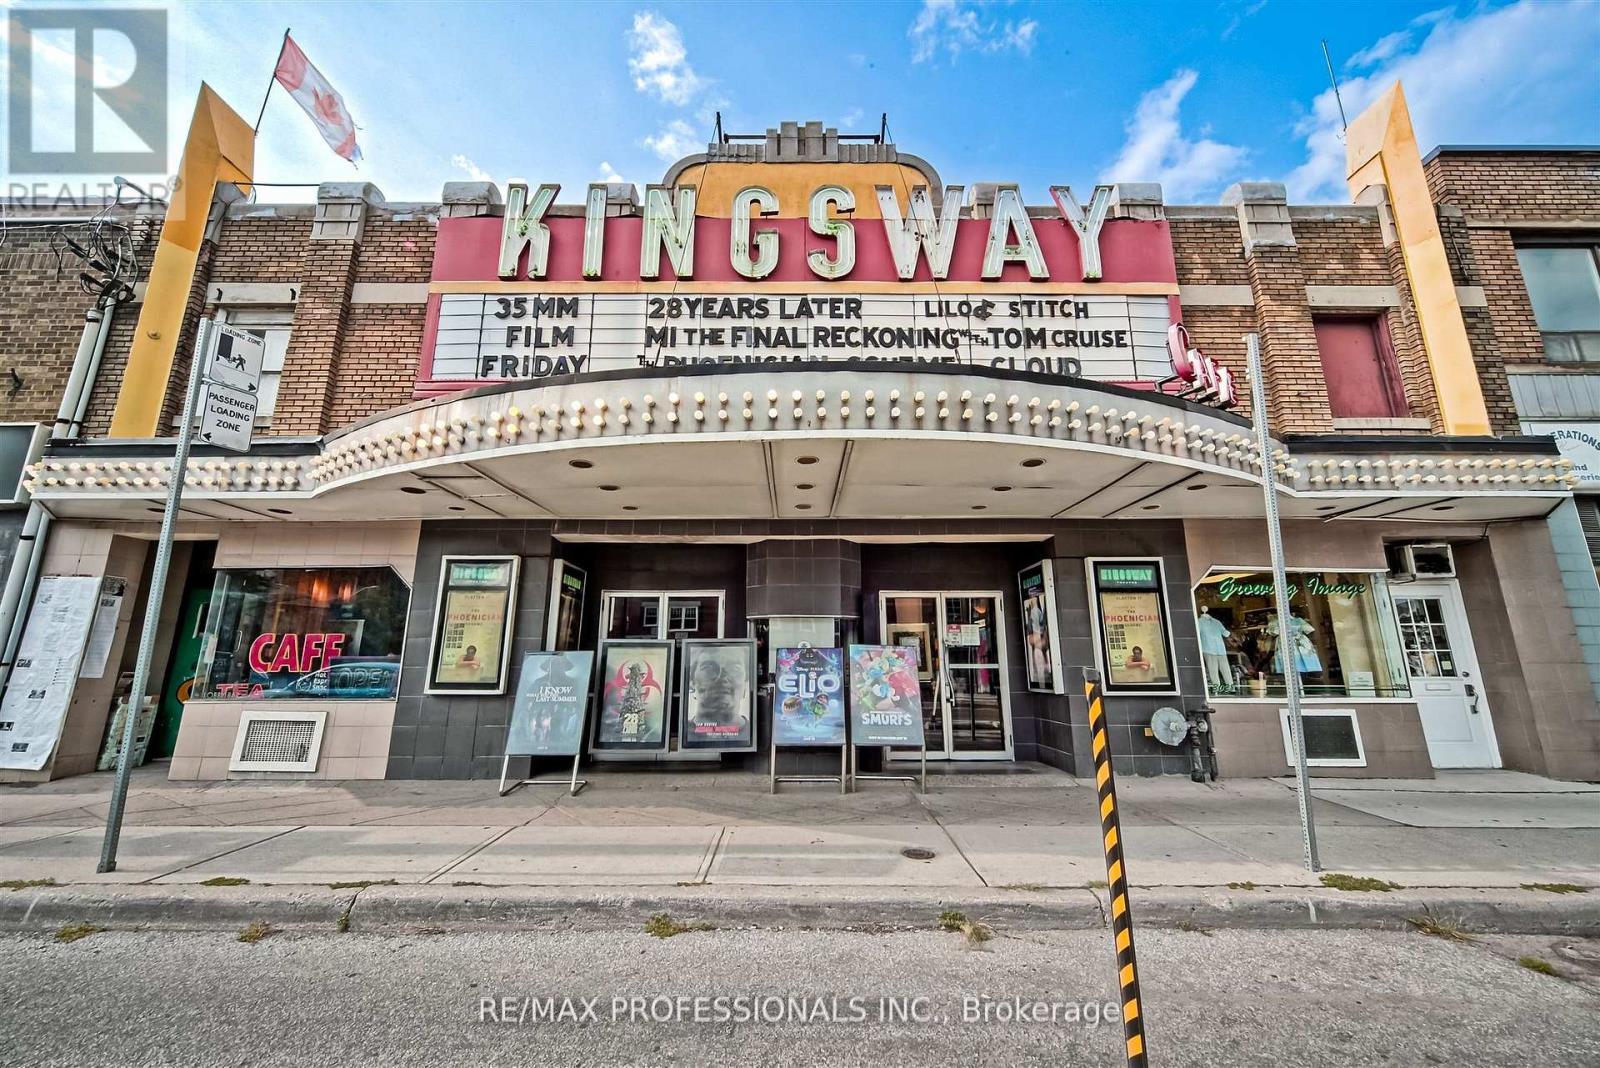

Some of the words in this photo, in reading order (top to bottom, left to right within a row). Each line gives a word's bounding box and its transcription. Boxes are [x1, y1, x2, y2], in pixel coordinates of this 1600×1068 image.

[497, 183, 1114, 280] KINGSWAY
[494, 297, 527, 319] 35
[532, 297, 579, 318] MM
[779, 297, 863, 319] LATER
[1008, 299, 1089, 319] STITCH
[220, 326, 245, 341] LOADING
[247, 335, 262, 347] ZONE
[505, 326, 575, 348] FILM
[645, 326, 676, 348] MI
[683, 328, 725, 346] THE
[731, 326, 807, 348] FINAL
[813, 326, 960, 349] RECKONING
[987, 327, 1047, 349] TOM
[1051, 329, 1128, 348] CRUISE
[480, 354, 588, 377] FRIDAY
[208, 391, 256, 412] PASSENGER
[210, 404, 251, 422] LOADING
[215, 418, 242, 433] ZONE
[1219, 577, 1299, 602] Growg
[1307, 576, 1367, 600] Image
[216, 682, 264, 699] TEA
[861, 713, 912, 726] SMURFS
